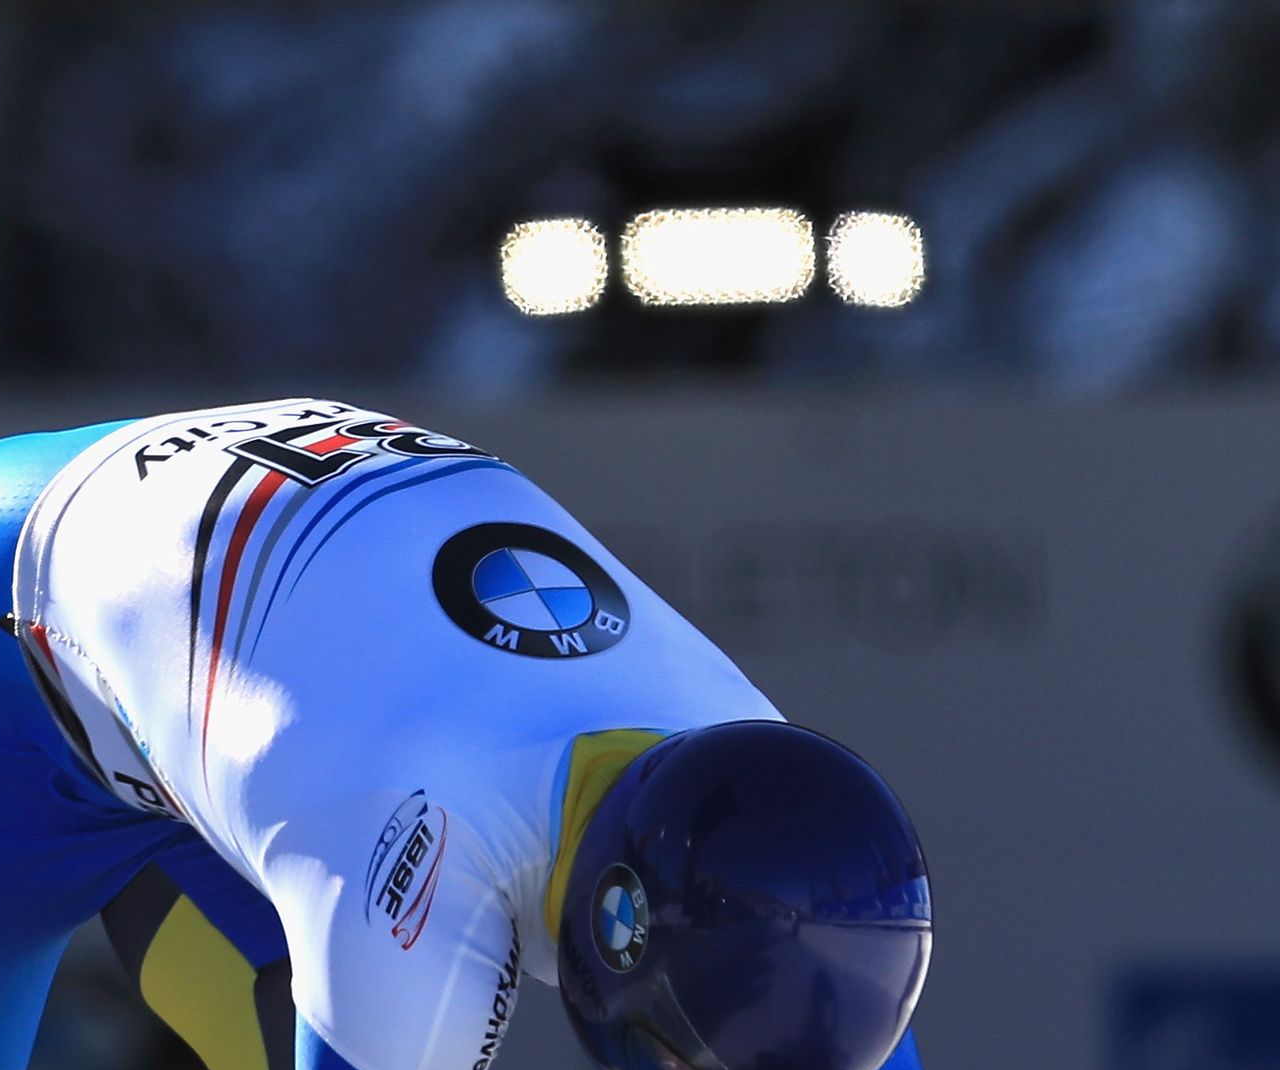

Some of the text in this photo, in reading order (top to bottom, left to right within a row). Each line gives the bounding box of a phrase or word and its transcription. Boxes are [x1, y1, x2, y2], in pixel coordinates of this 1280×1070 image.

[134, 419, 269, 481] City
[482, 608, 625, 655] BMW
[385, 819, 435, 920] IBSF
[620, 888, 646, 969] BMW
